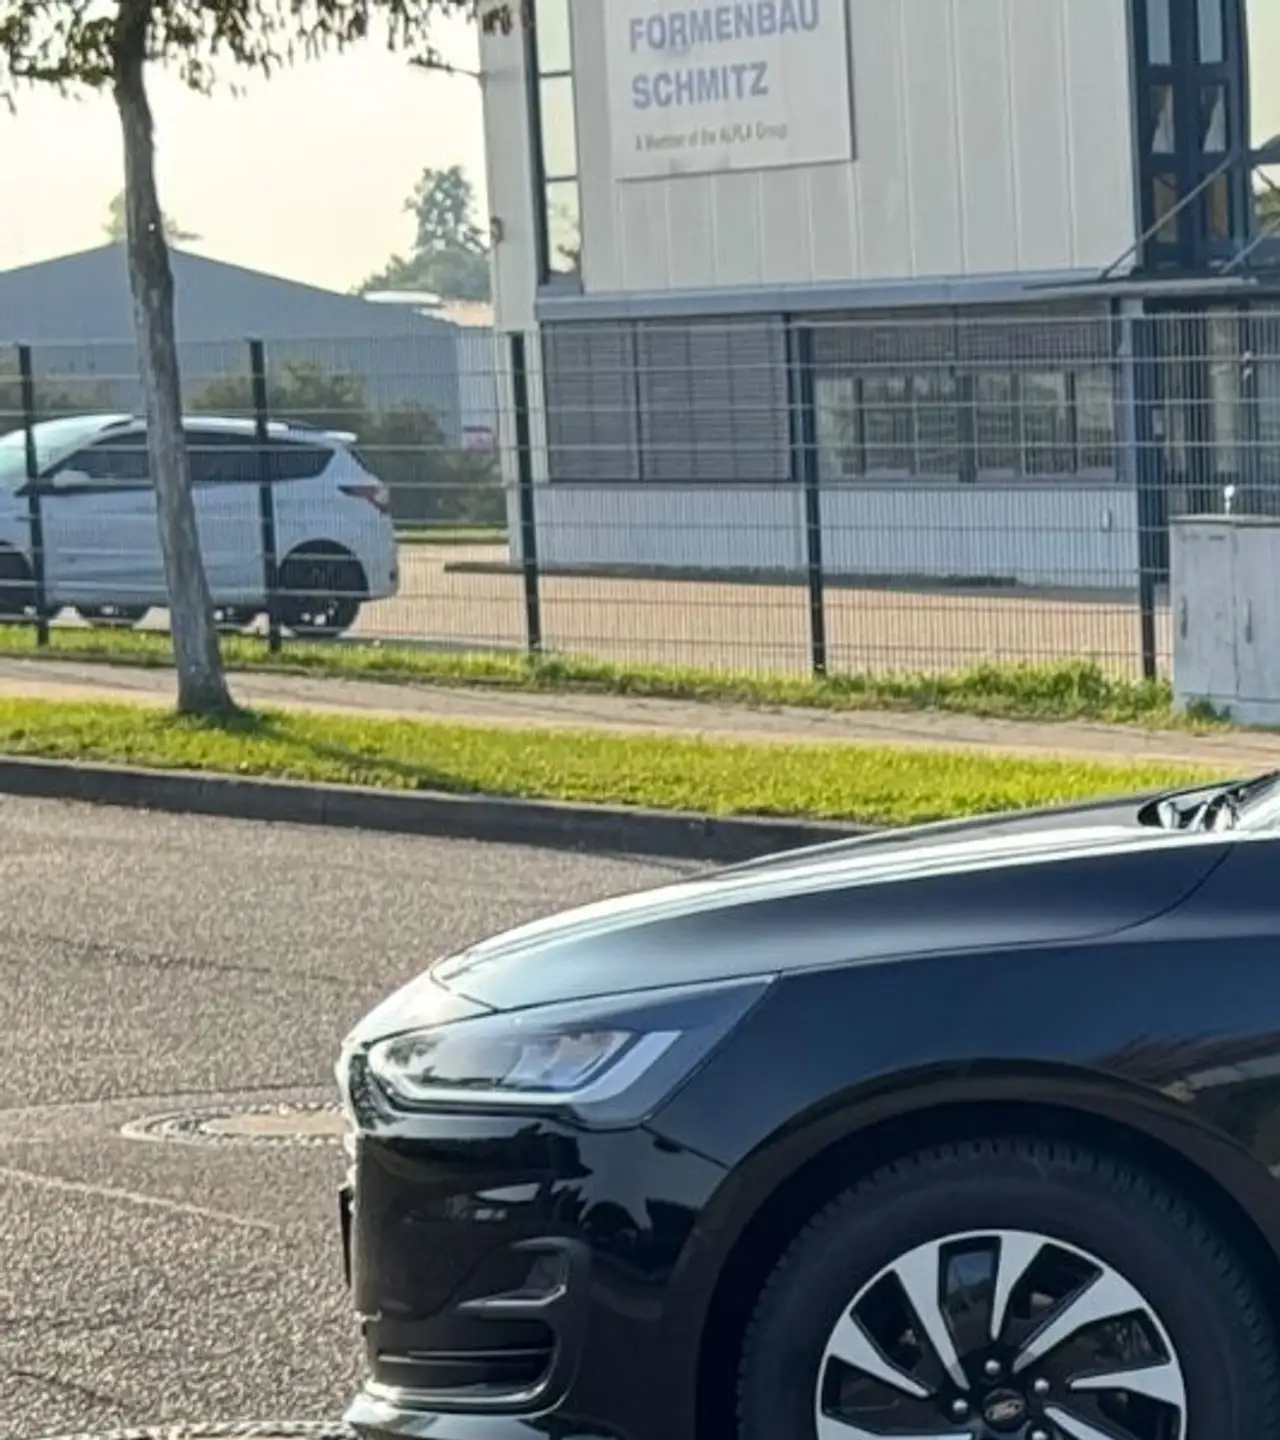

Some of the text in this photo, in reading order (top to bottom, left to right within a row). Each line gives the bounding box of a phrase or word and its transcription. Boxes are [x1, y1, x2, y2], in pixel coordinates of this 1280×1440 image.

[629, 0, 820, 53] FORMENBAU
[631, 60, 769, 111] SCHMITZ
[634, 134, 643, 151] A
